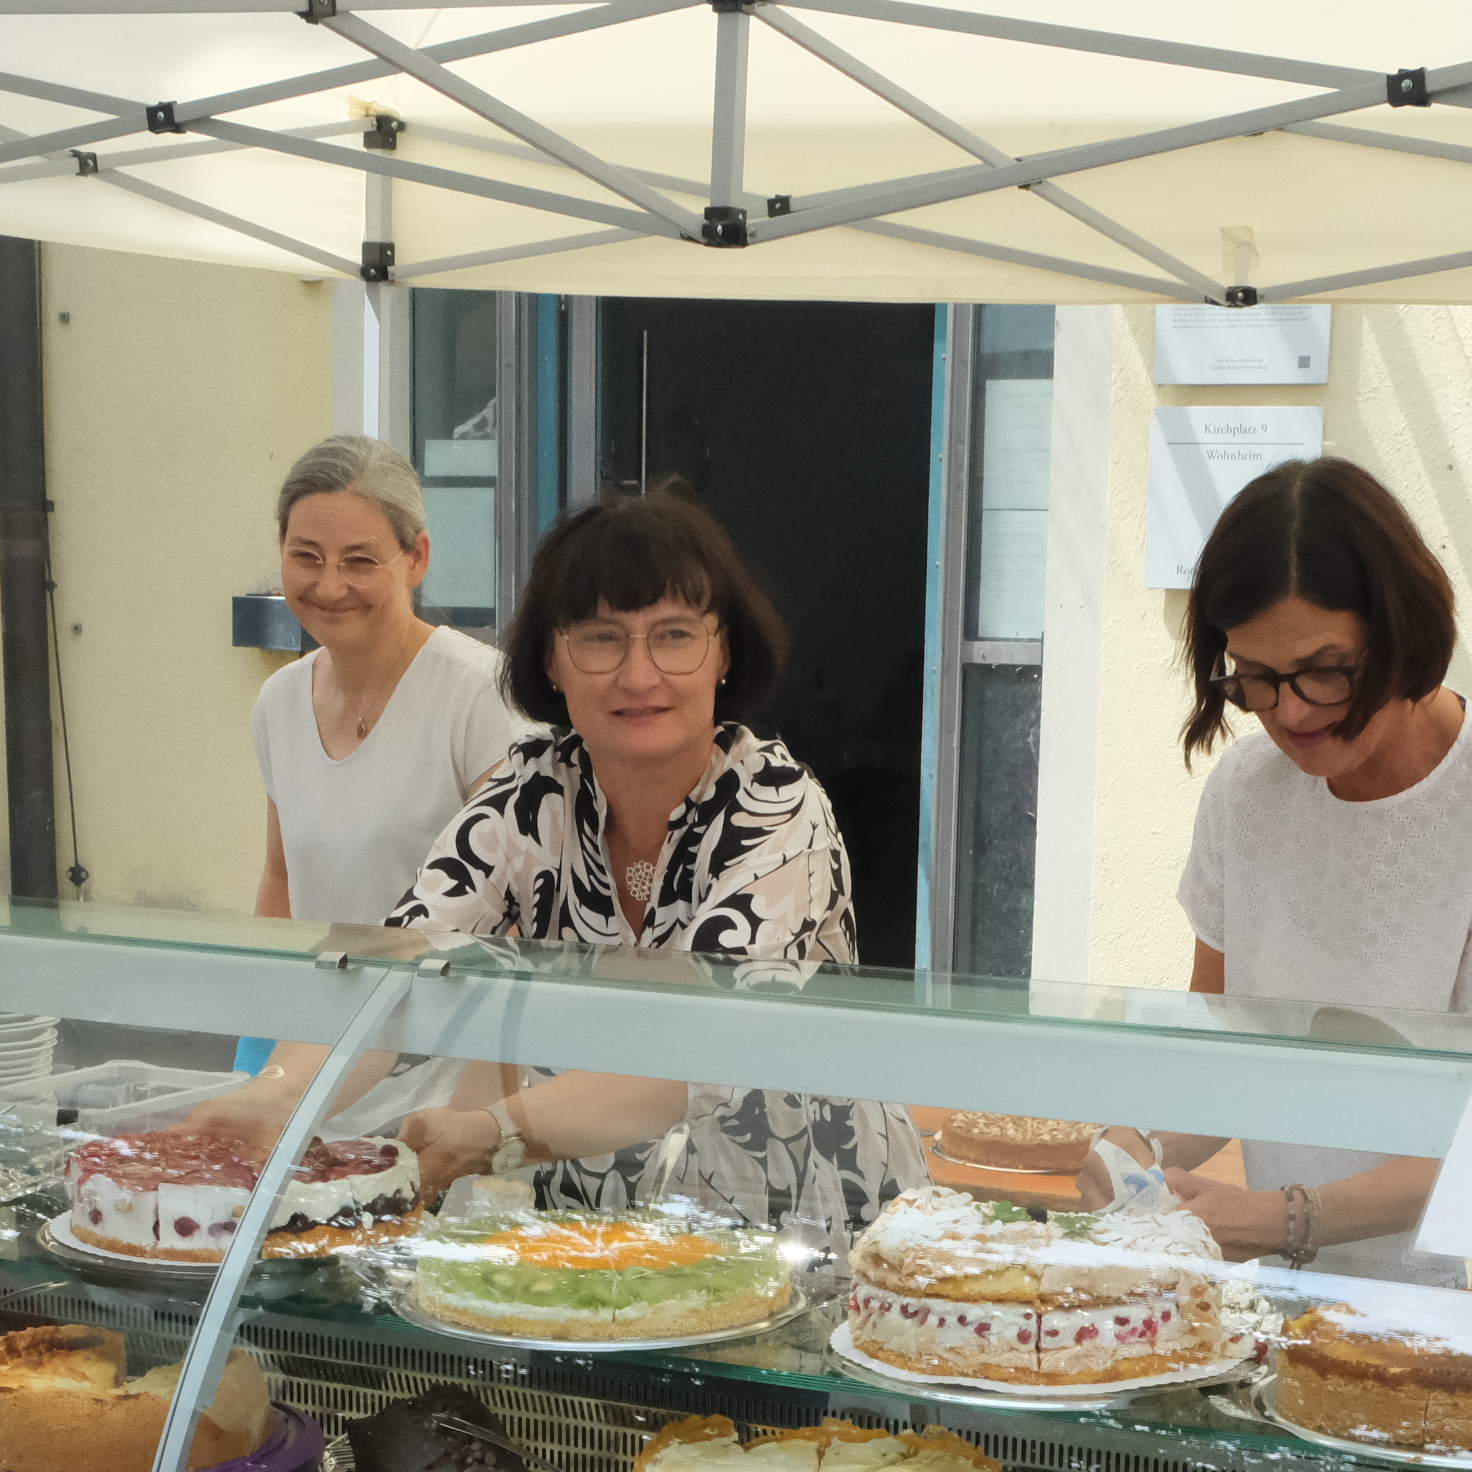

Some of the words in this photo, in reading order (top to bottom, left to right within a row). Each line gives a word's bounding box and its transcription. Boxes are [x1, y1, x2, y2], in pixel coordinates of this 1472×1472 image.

[1204, 423, 1258, 438] Kirchplatz
[1261, 423, 1268, 435] 9
[1206, 449, 1263, 461] Wohnheim
